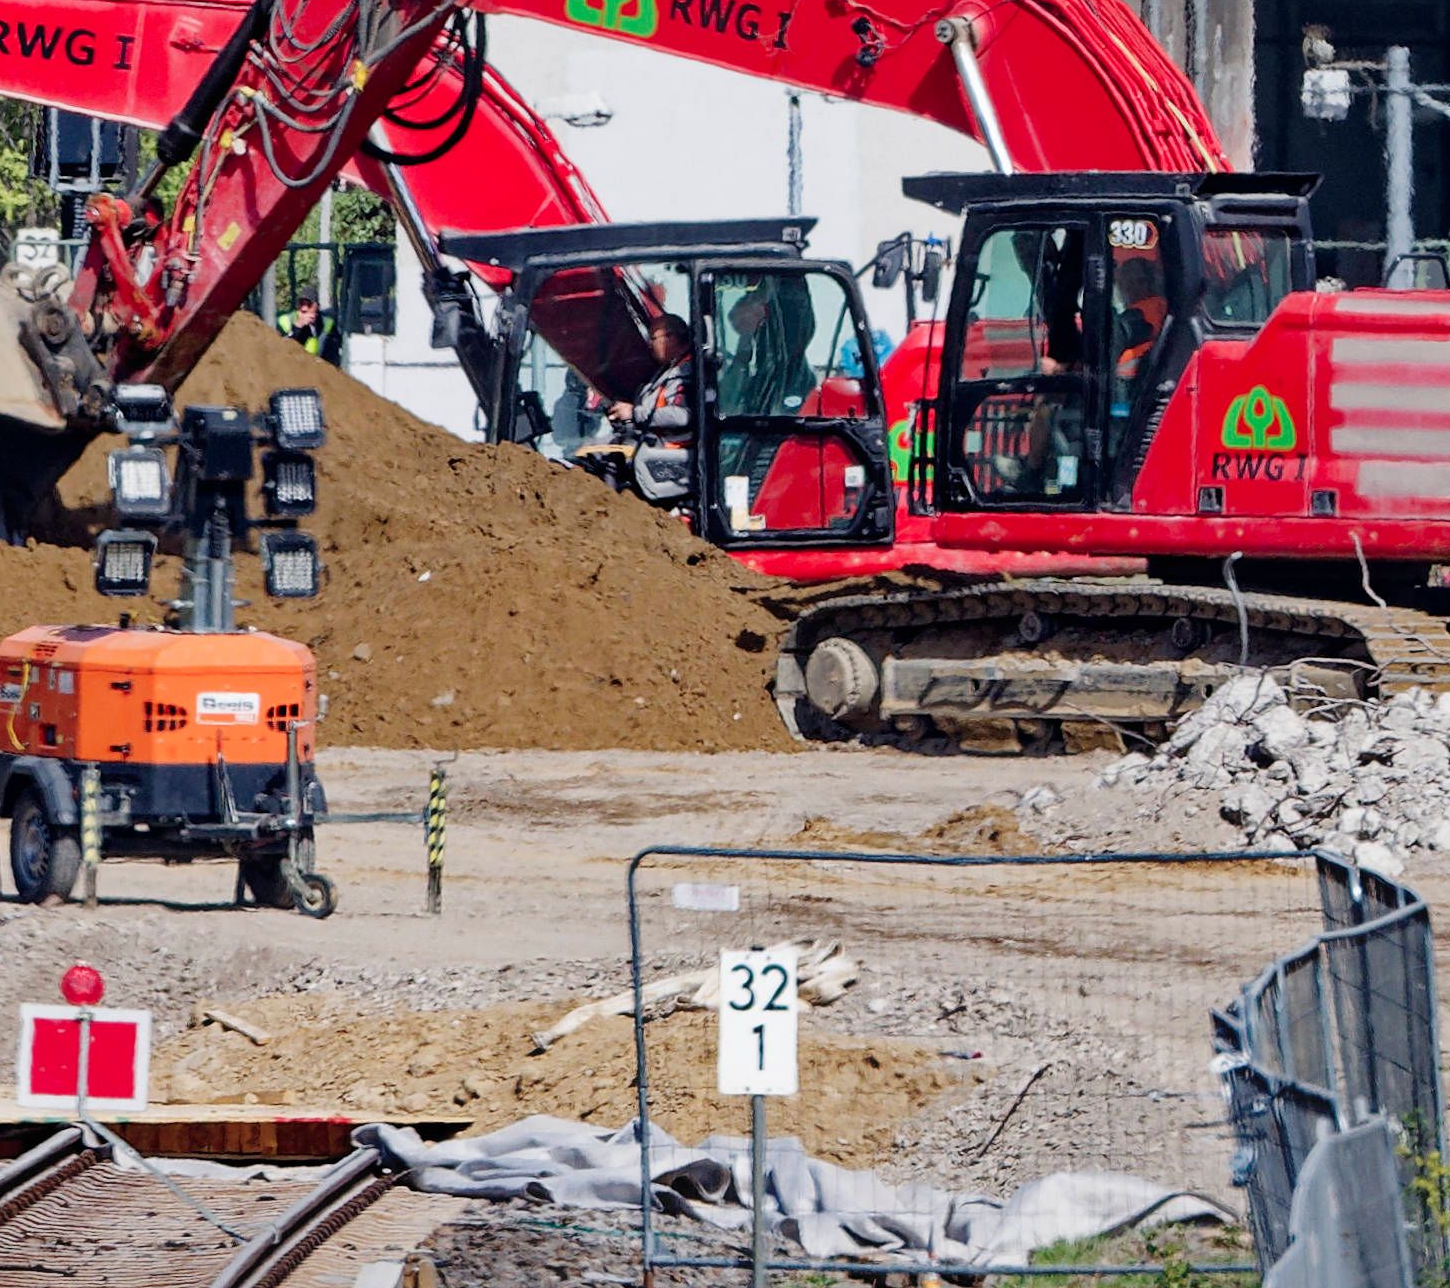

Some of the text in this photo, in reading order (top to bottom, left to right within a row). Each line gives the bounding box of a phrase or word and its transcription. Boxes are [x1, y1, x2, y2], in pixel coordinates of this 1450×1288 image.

[1108, 219, 1148, 246] 330
[1211, 452, 1285, 481] RWG
[728, 964, 790, 1012] 32
[752, 1024, 766, 1071] 1
